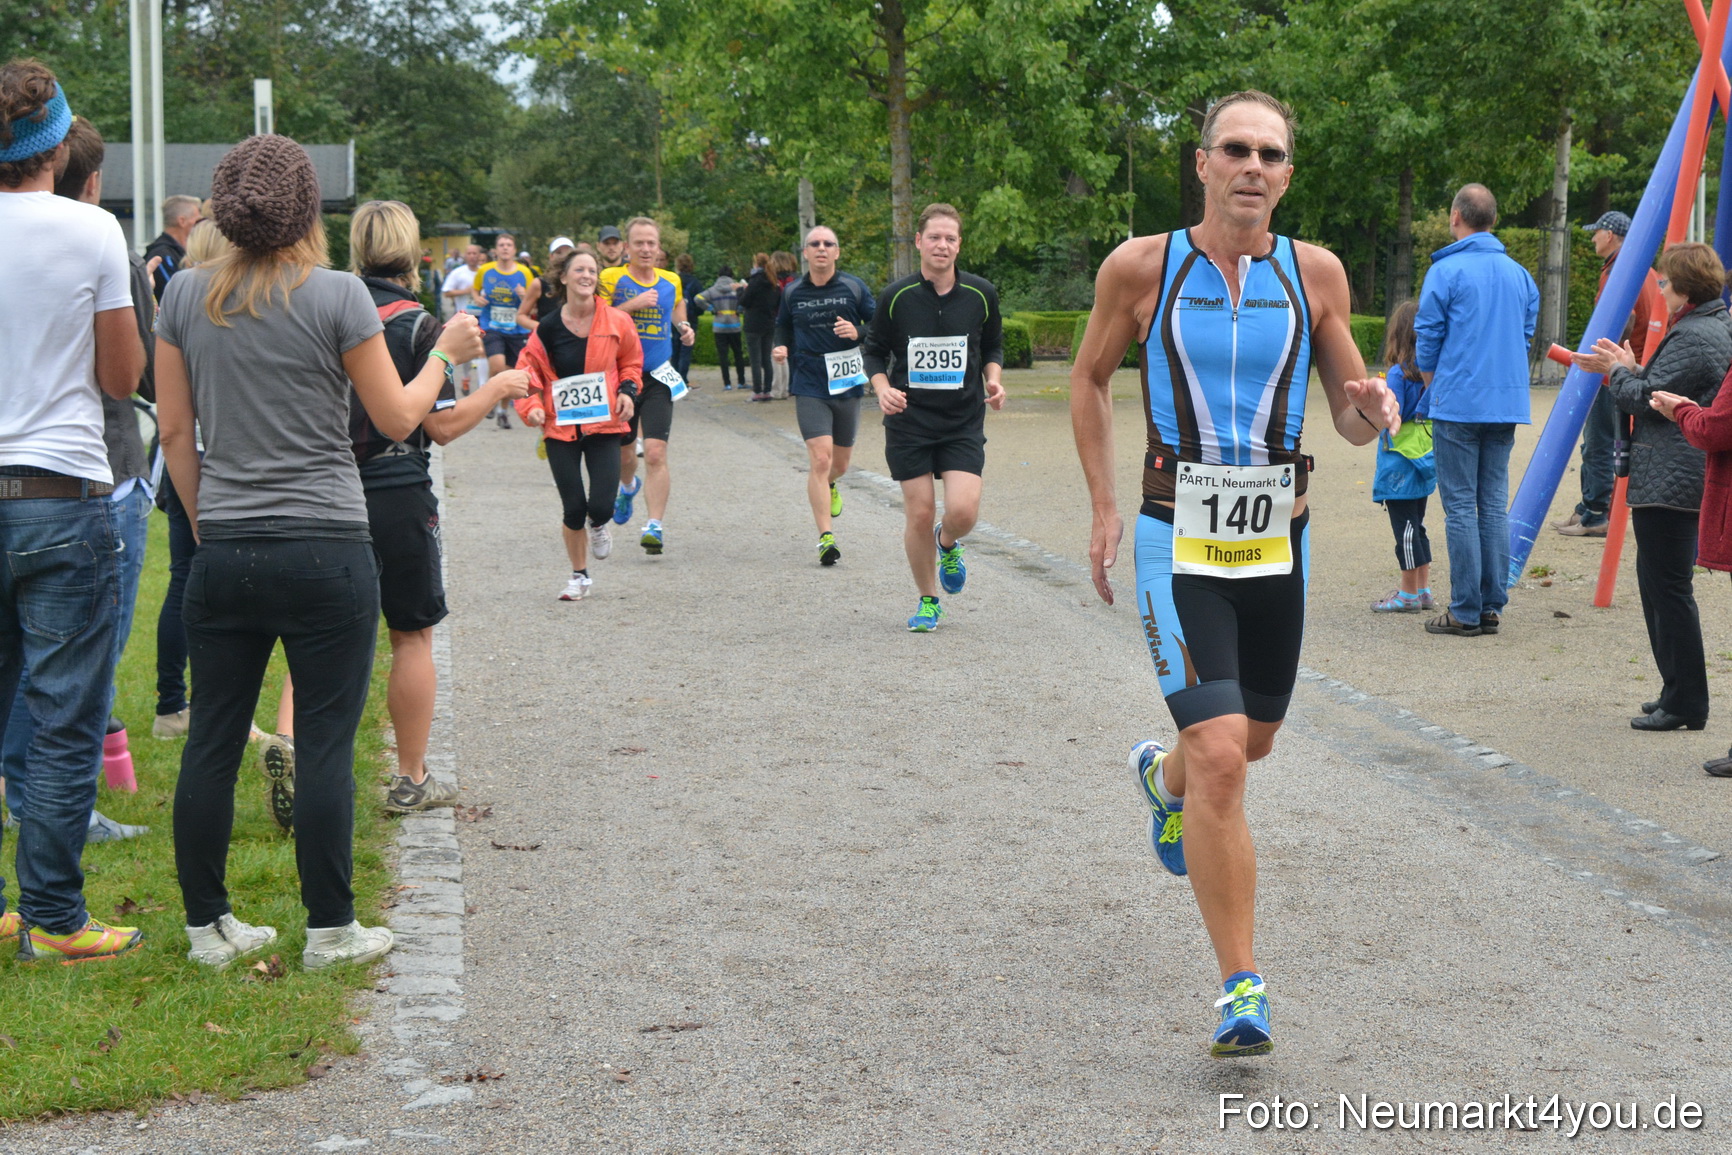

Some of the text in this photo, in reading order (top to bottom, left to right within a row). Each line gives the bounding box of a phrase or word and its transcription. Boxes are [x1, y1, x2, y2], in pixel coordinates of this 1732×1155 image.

[797, 298, 847, 309] DELPHI
[915, 350, 962, 369] 2395
[919, 373, 957, 382] Sebastian
[559, 385, 602, 407] 2334
[1179, 473, 1276, 489] PARTL Neumarkt
[1202, 493, 1272, 535] 140
[1178, 528, 1184, 536] B
[1204, 545, 1262, 563] Thomas
